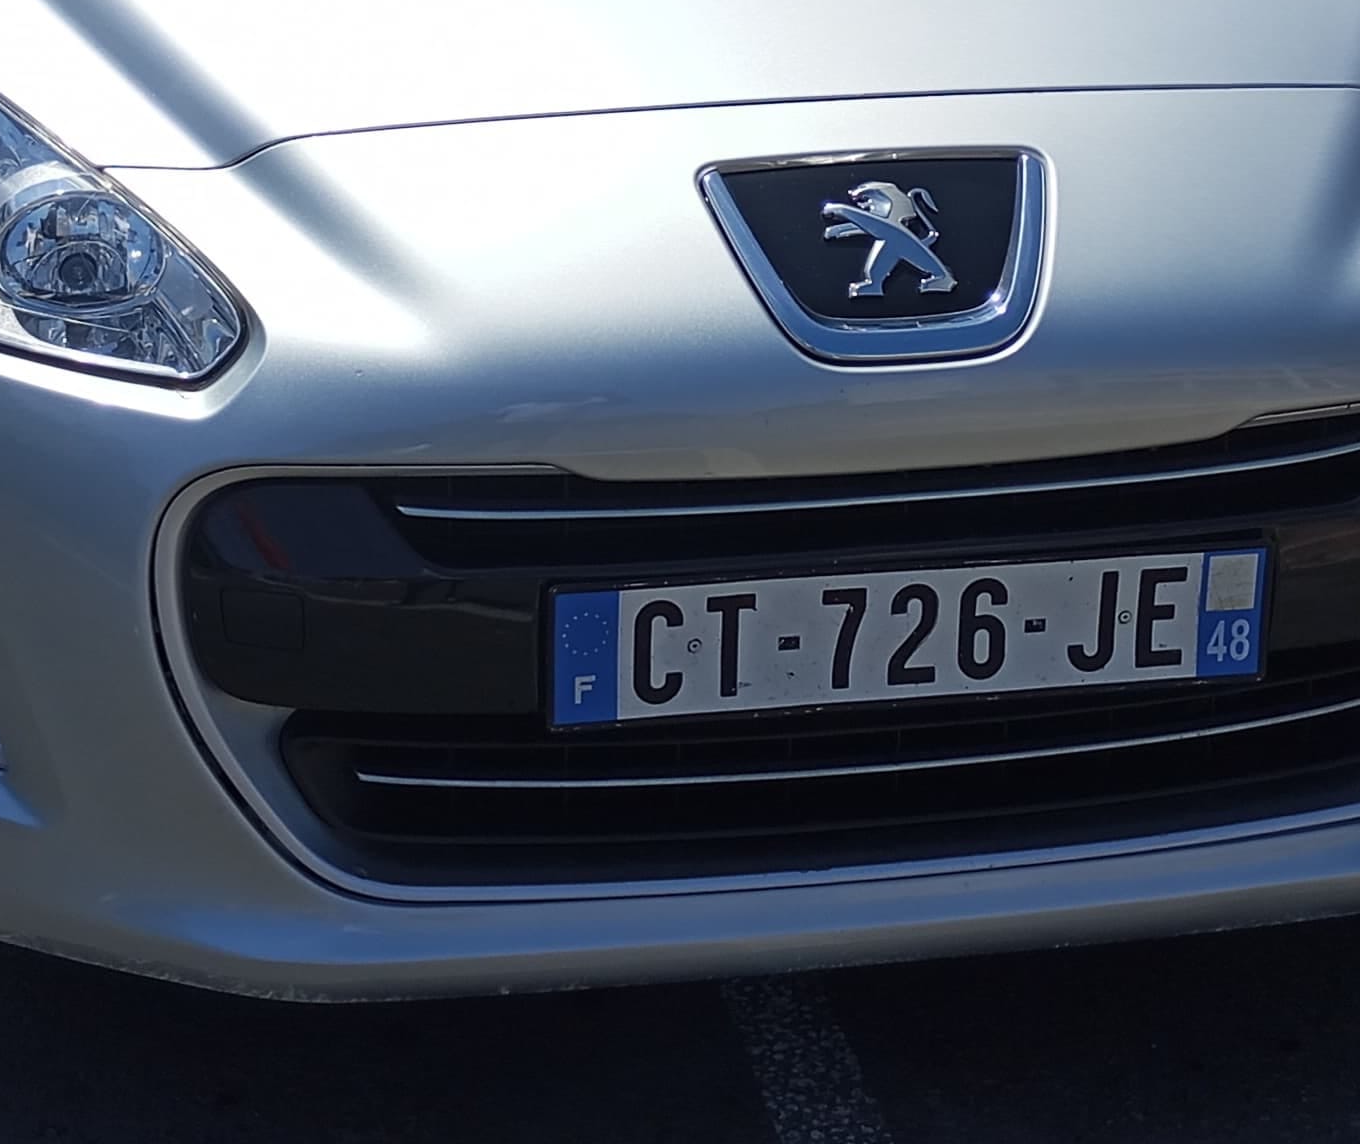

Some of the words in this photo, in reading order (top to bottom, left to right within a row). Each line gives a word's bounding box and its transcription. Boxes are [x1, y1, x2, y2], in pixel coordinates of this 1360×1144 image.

[633, 566, 1189, 706] CT-726-JE
[1206, 618, 1252, 663] 48
[572, 675, 597, 706] F
